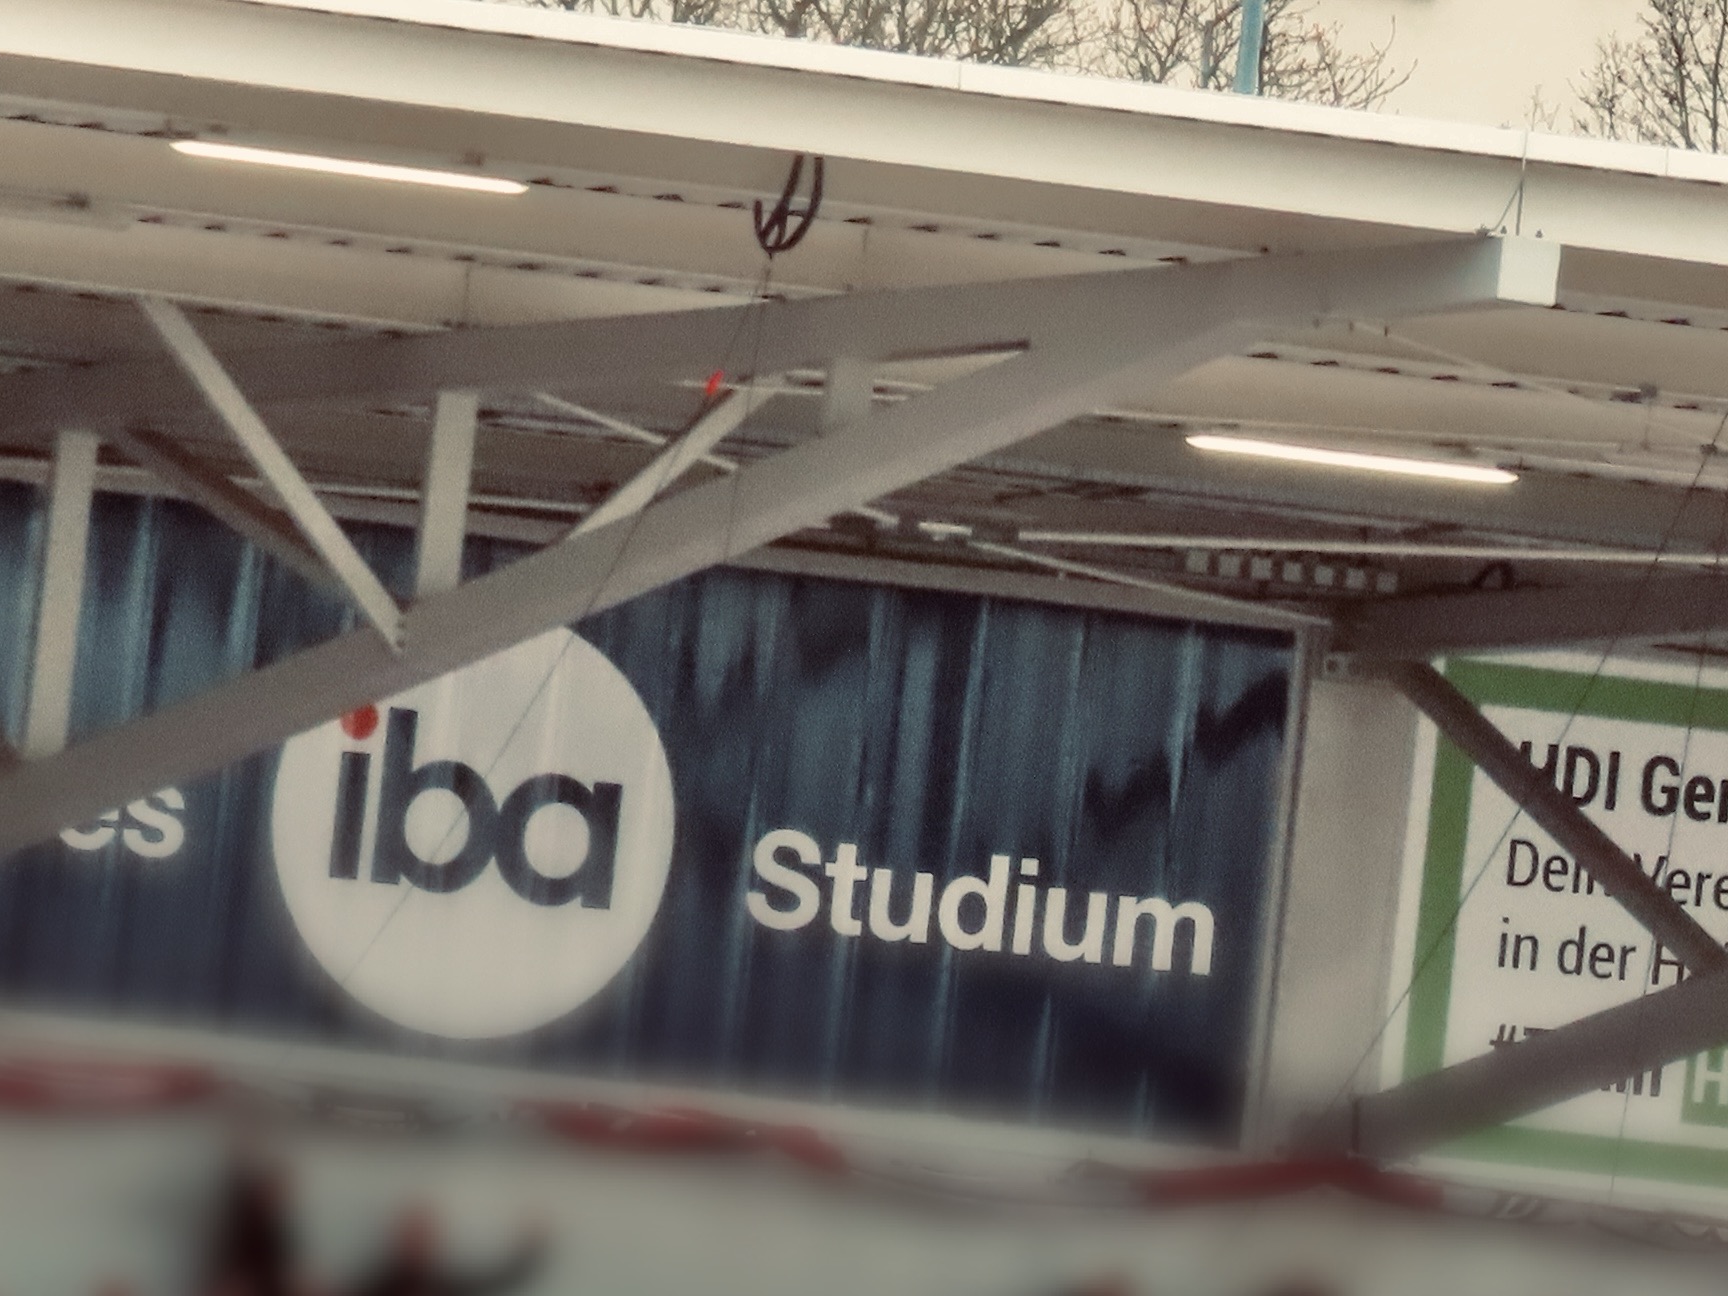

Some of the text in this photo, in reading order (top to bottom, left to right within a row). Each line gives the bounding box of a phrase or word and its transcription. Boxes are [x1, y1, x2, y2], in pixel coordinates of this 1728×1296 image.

[329, 702, 623, 910] iba
[746, 828, 1216, 976] Studium
[1498, 917, 1539, 972] in
[1557, 926, 1636, 982] der
